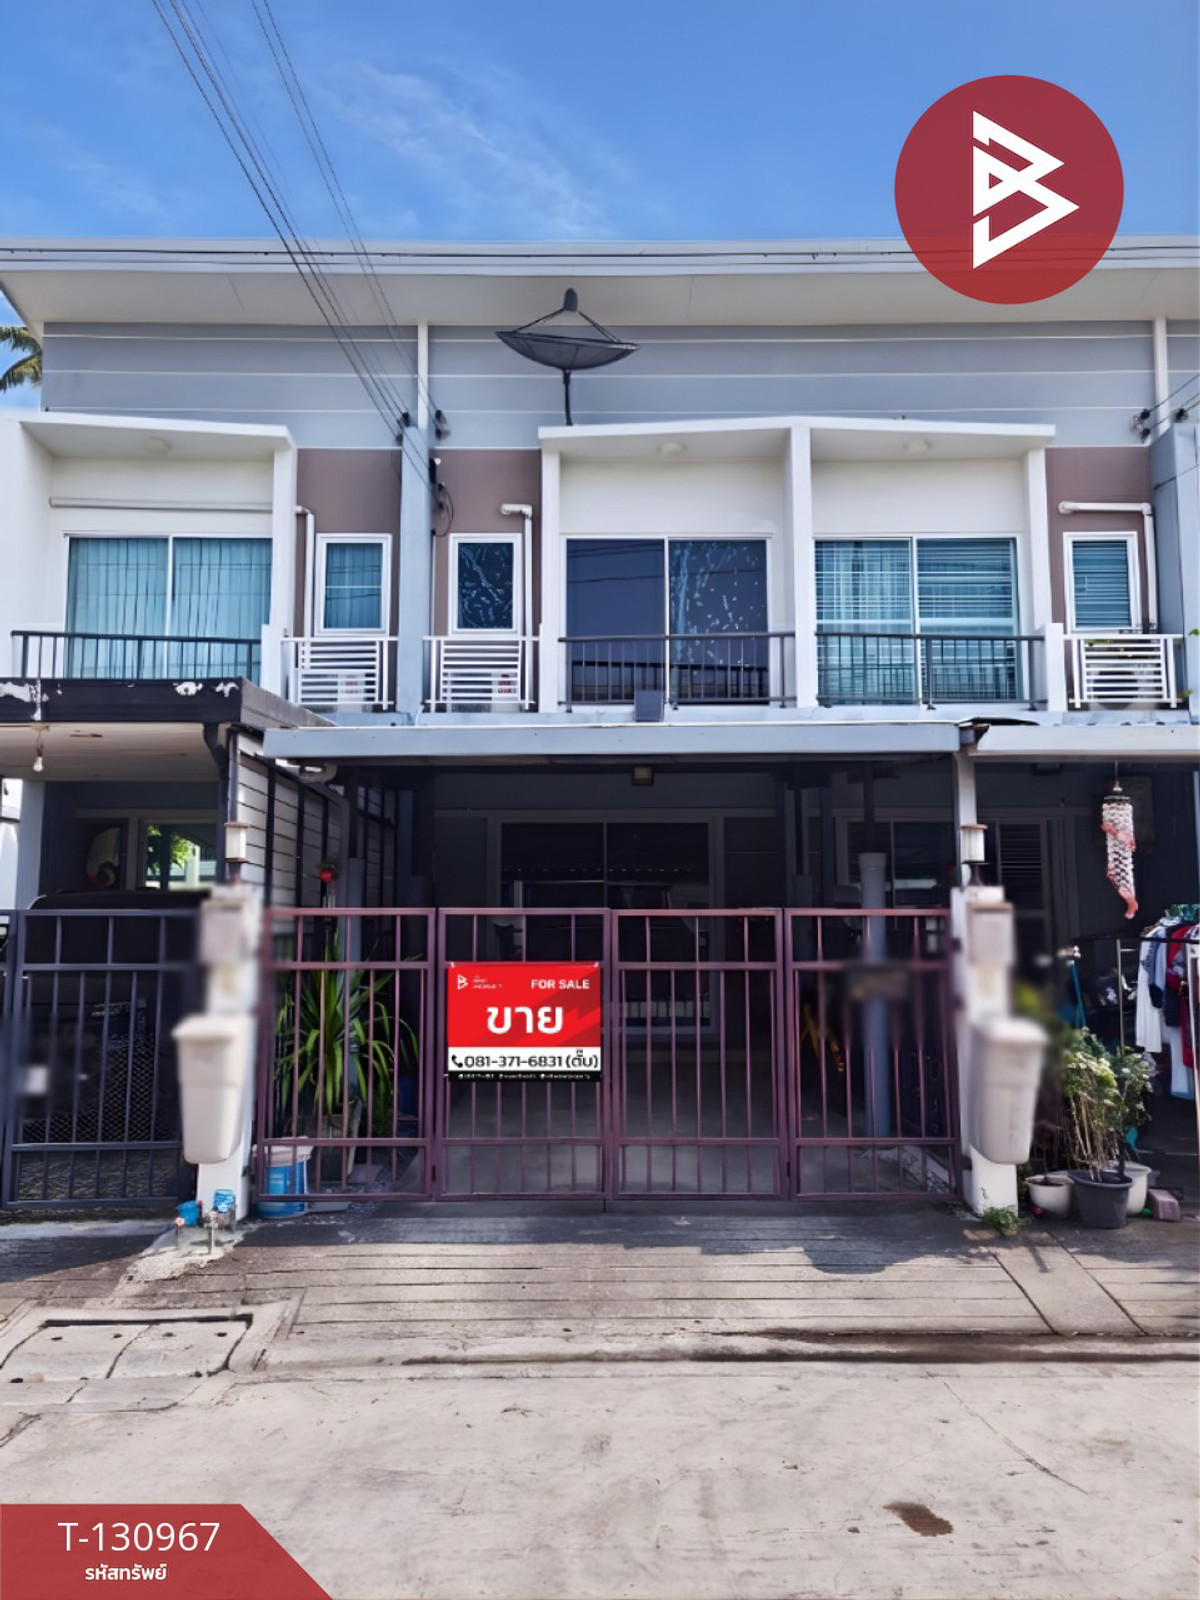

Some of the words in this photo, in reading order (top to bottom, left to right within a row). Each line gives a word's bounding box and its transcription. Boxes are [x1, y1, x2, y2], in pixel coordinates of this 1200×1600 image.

[530, 979, 556, 990] FOR
[558, 979, 590, 990] SALE
[486, 1005, 564, 1034] ขาย
[464, 1055, 563, 1068] 081-371-6831
